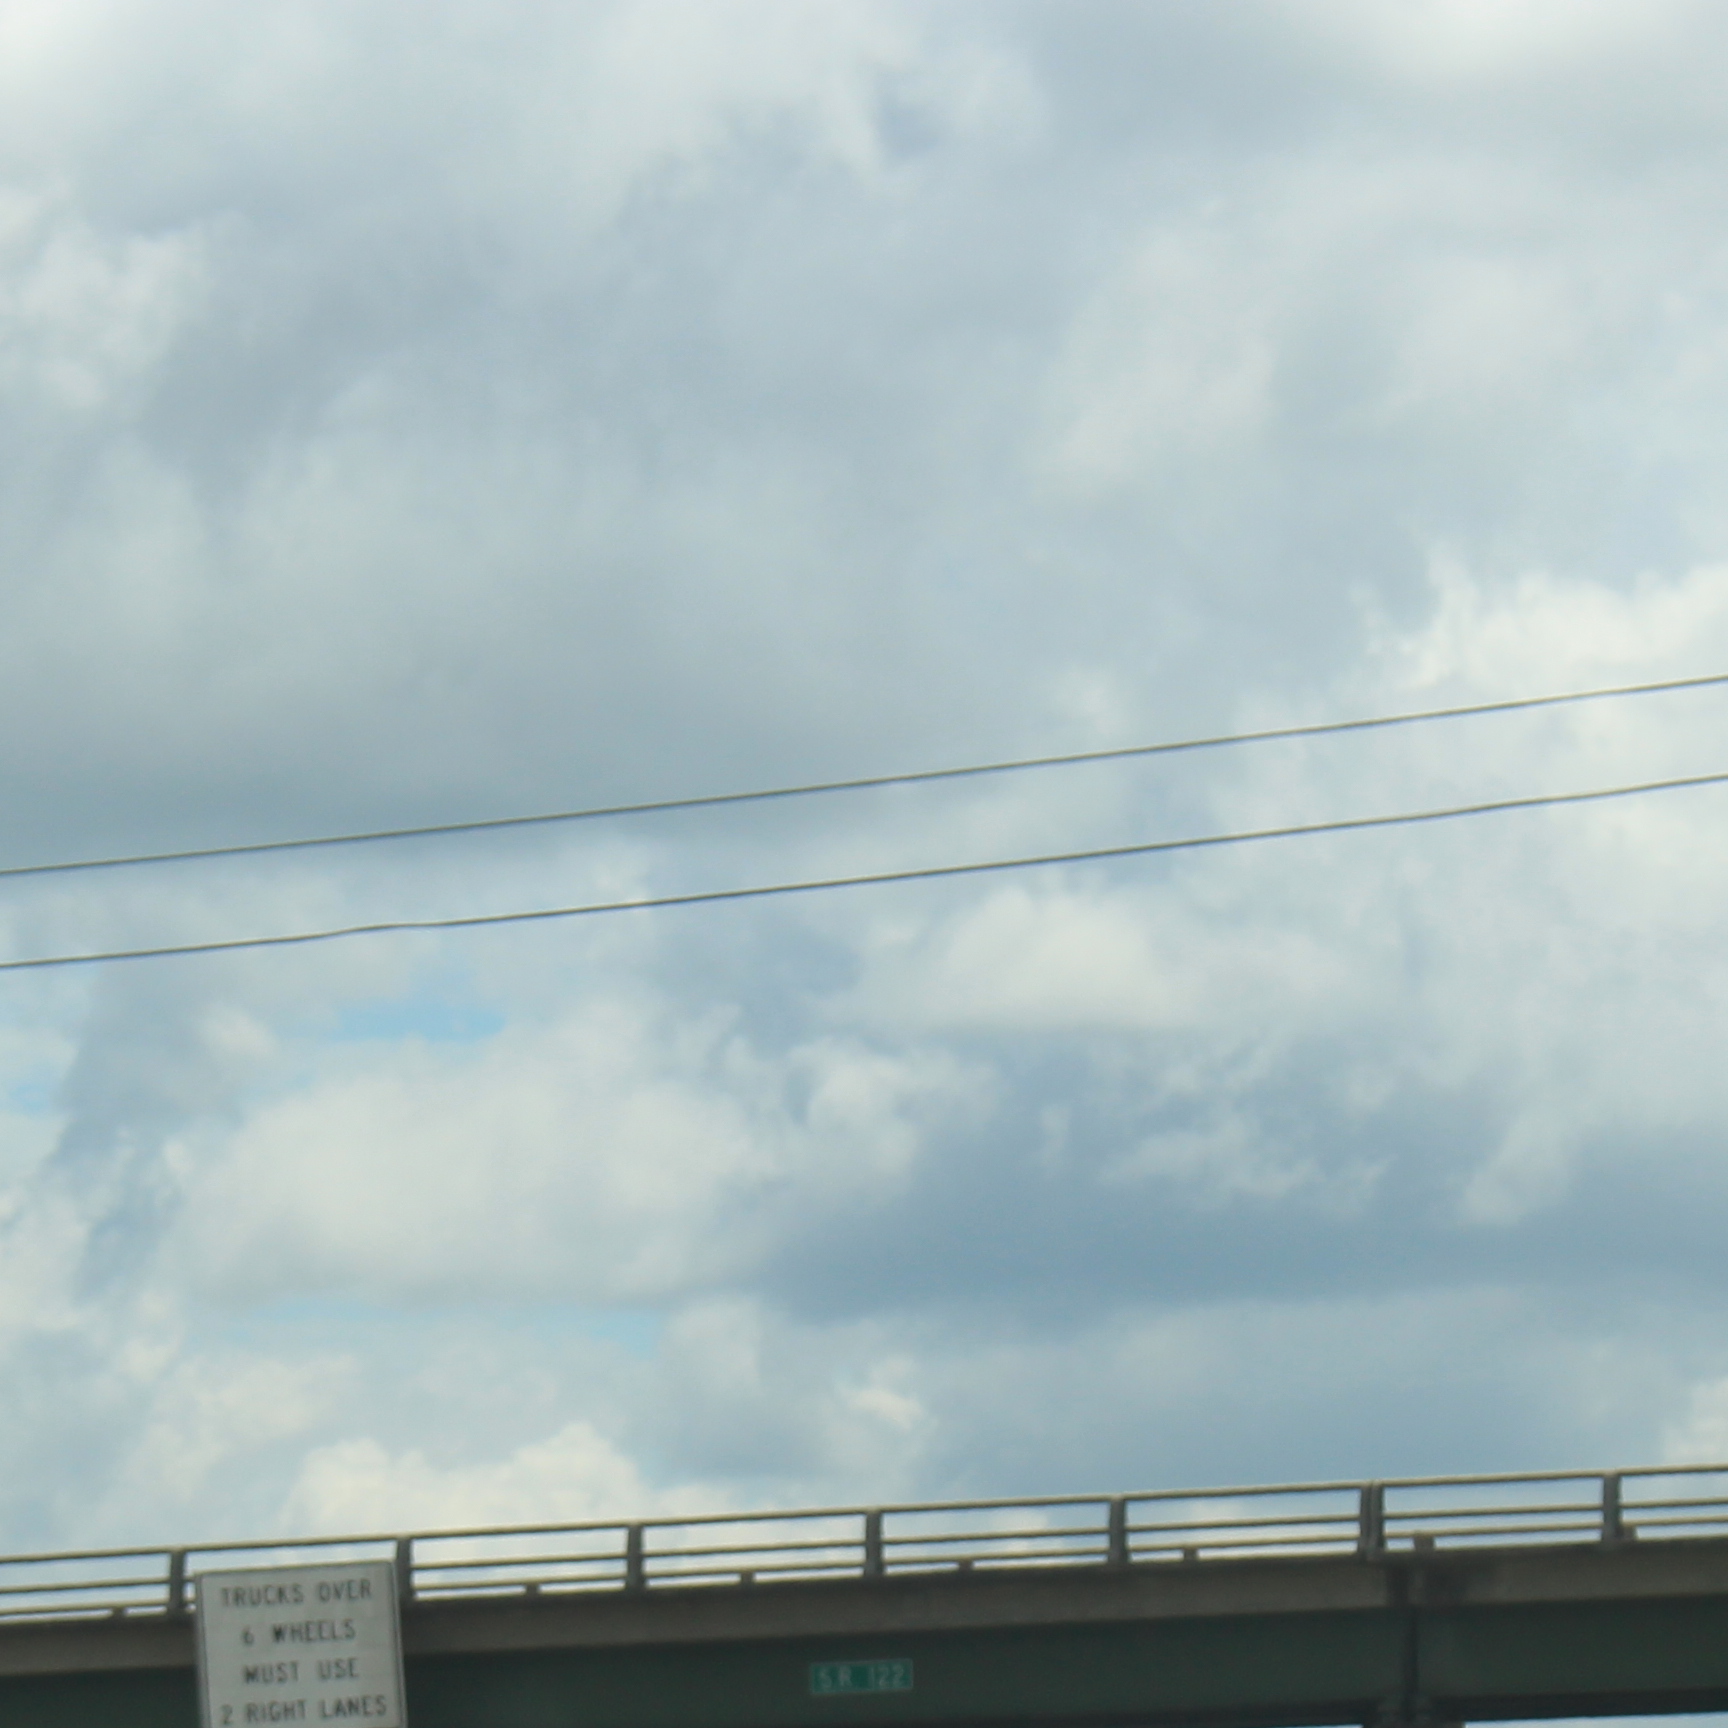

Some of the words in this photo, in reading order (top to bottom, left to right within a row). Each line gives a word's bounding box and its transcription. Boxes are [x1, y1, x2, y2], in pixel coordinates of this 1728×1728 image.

[221, 1582, 305, 1607] TRUCKS
[317, 1578, 372, 1601] OVER
[241, 1626, 255, 1646] 6
[271, 1618, 356, 1644] WHEELS
[243, 1660, 300, 1684] MUST
[318, 1657, 359, 1681] USE
[869, 1663, 904, 1687] 122
[221, 1704, 234, 1725] 2
[245, 1699, 307, 1723] RIGHT
[321, 1695, 387, 1718] LANES
